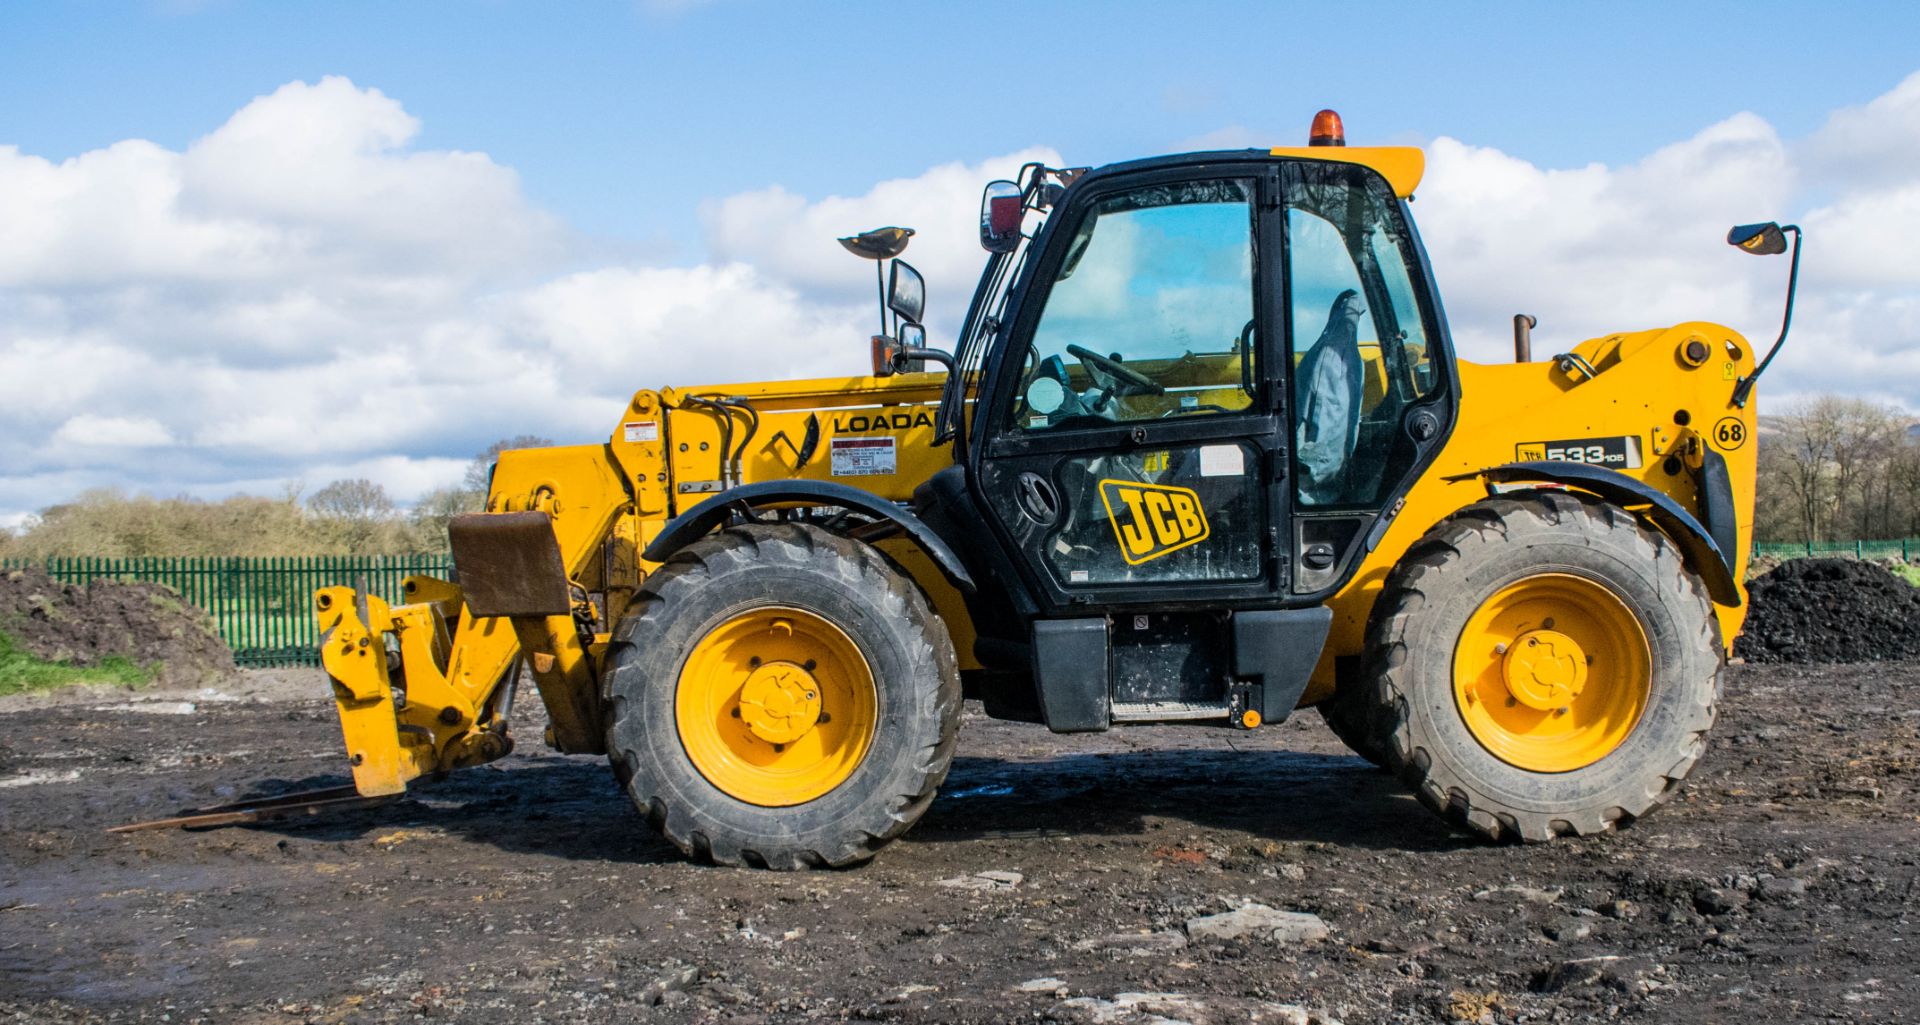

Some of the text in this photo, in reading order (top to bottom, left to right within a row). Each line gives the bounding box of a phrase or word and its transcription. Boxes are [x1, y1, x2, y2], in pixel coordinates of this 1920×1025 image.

[834, 412, 938, 433] LOADA
[1719, 424, 1742, 442] 68
[1547, 446, 1605, 464] 533
[1604, 454, 1624, 462] 105
[1118, 488, 1203, 556] JCB
